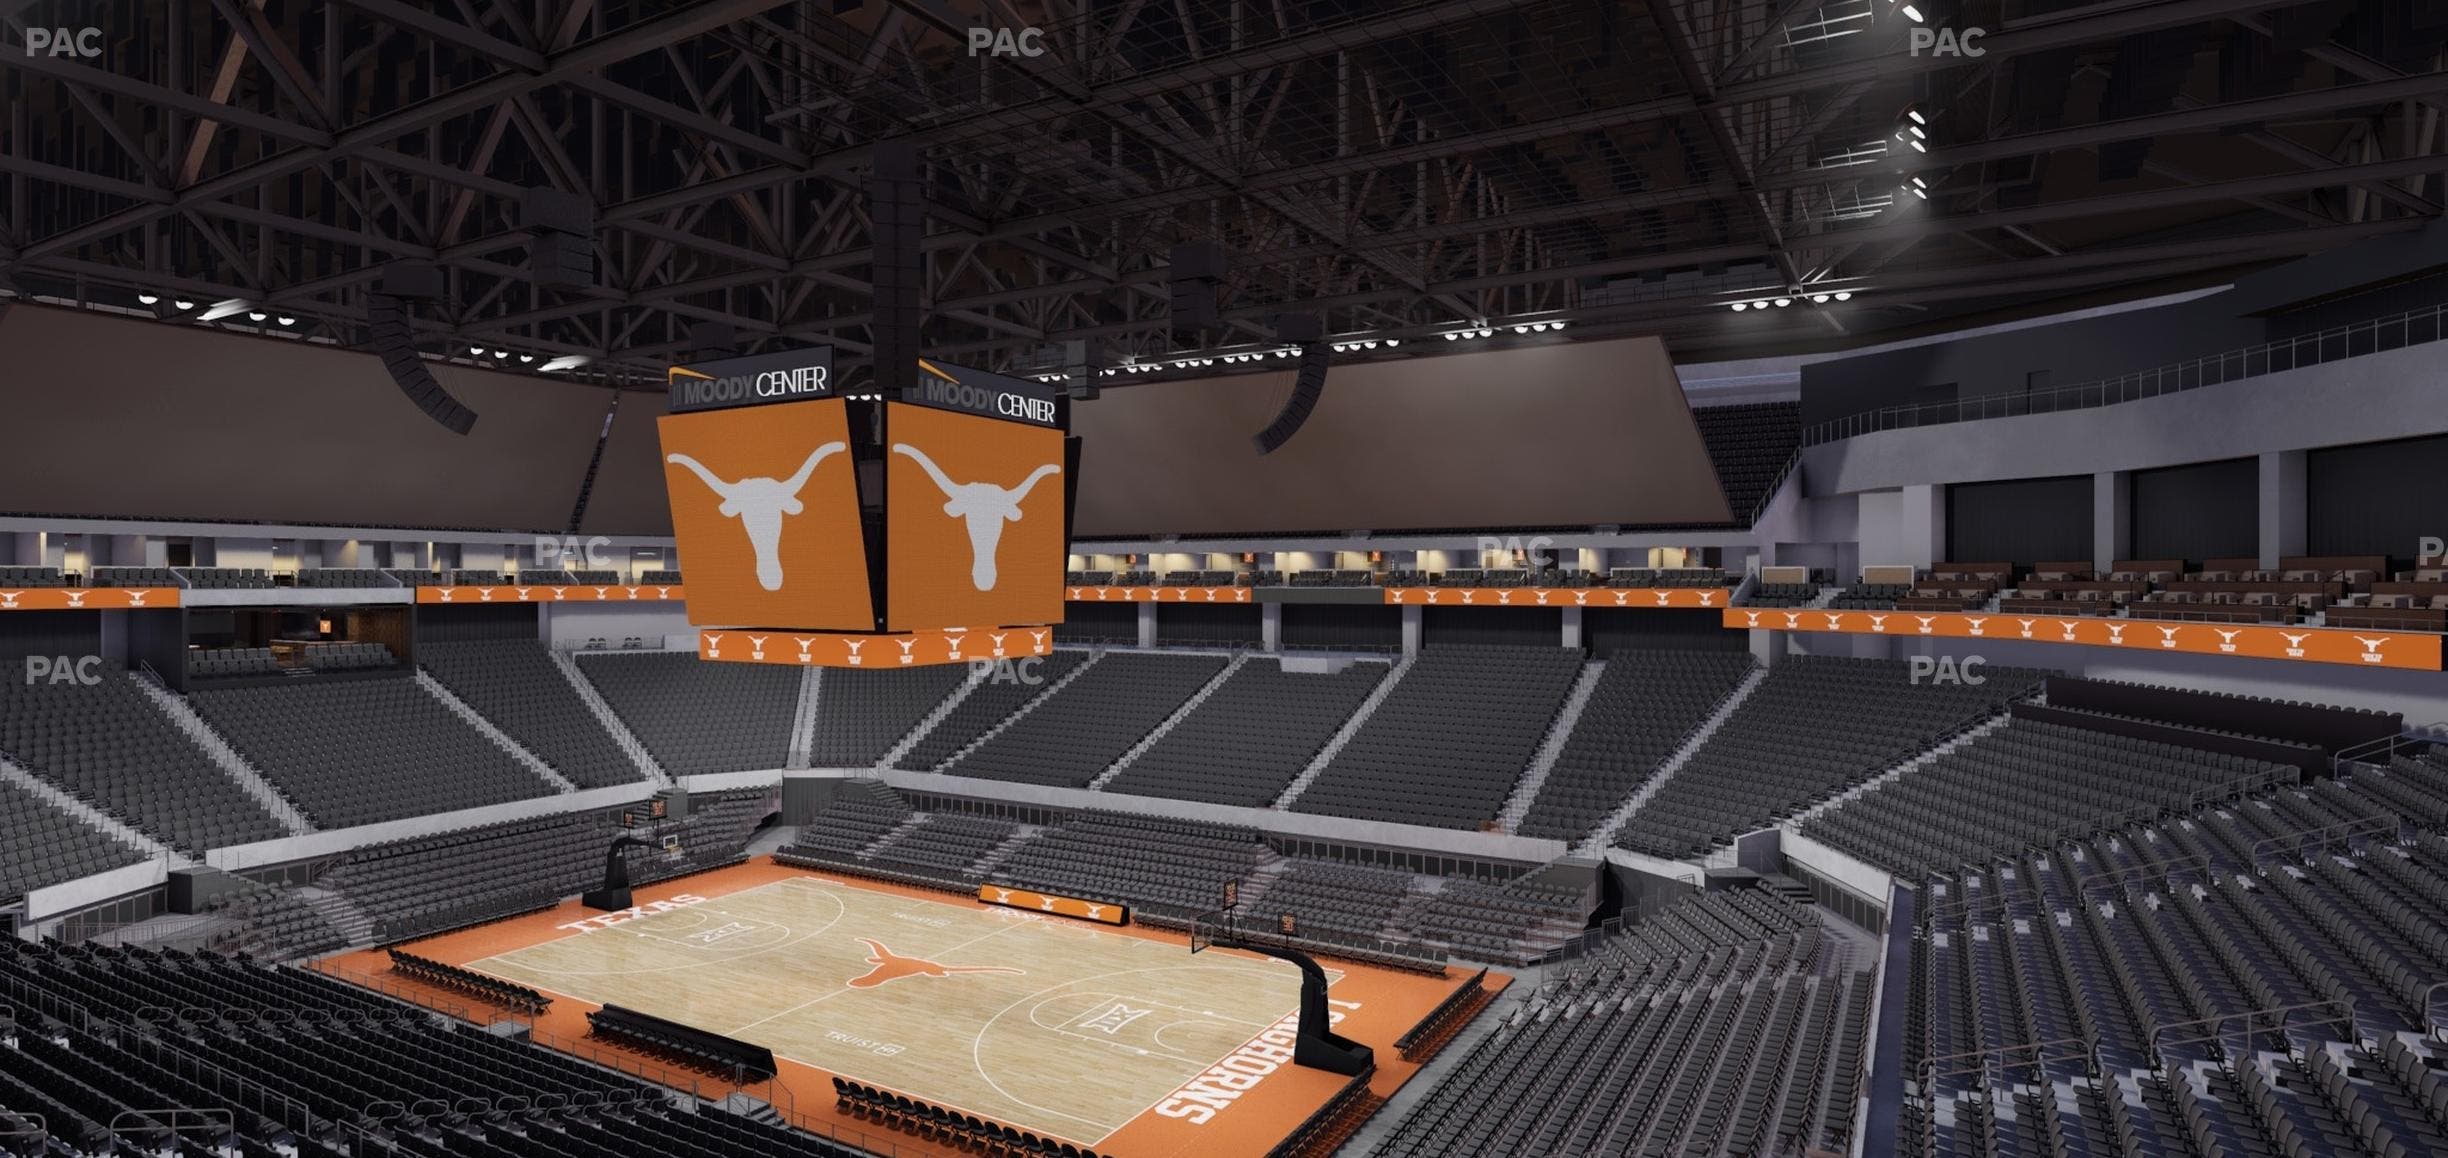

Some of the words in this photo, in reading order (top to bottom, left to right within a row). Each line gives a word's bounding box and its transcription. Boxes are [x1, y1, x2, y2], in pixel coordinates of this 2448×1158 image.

[684, 374, 755, 406] MOODY
[756, 366, 827, 397] CENTER
[926, 377, 998, 412] MOODY
[997, 392, 1056, 423] CENTER
[556, 894, 707, 934] TEXAS
